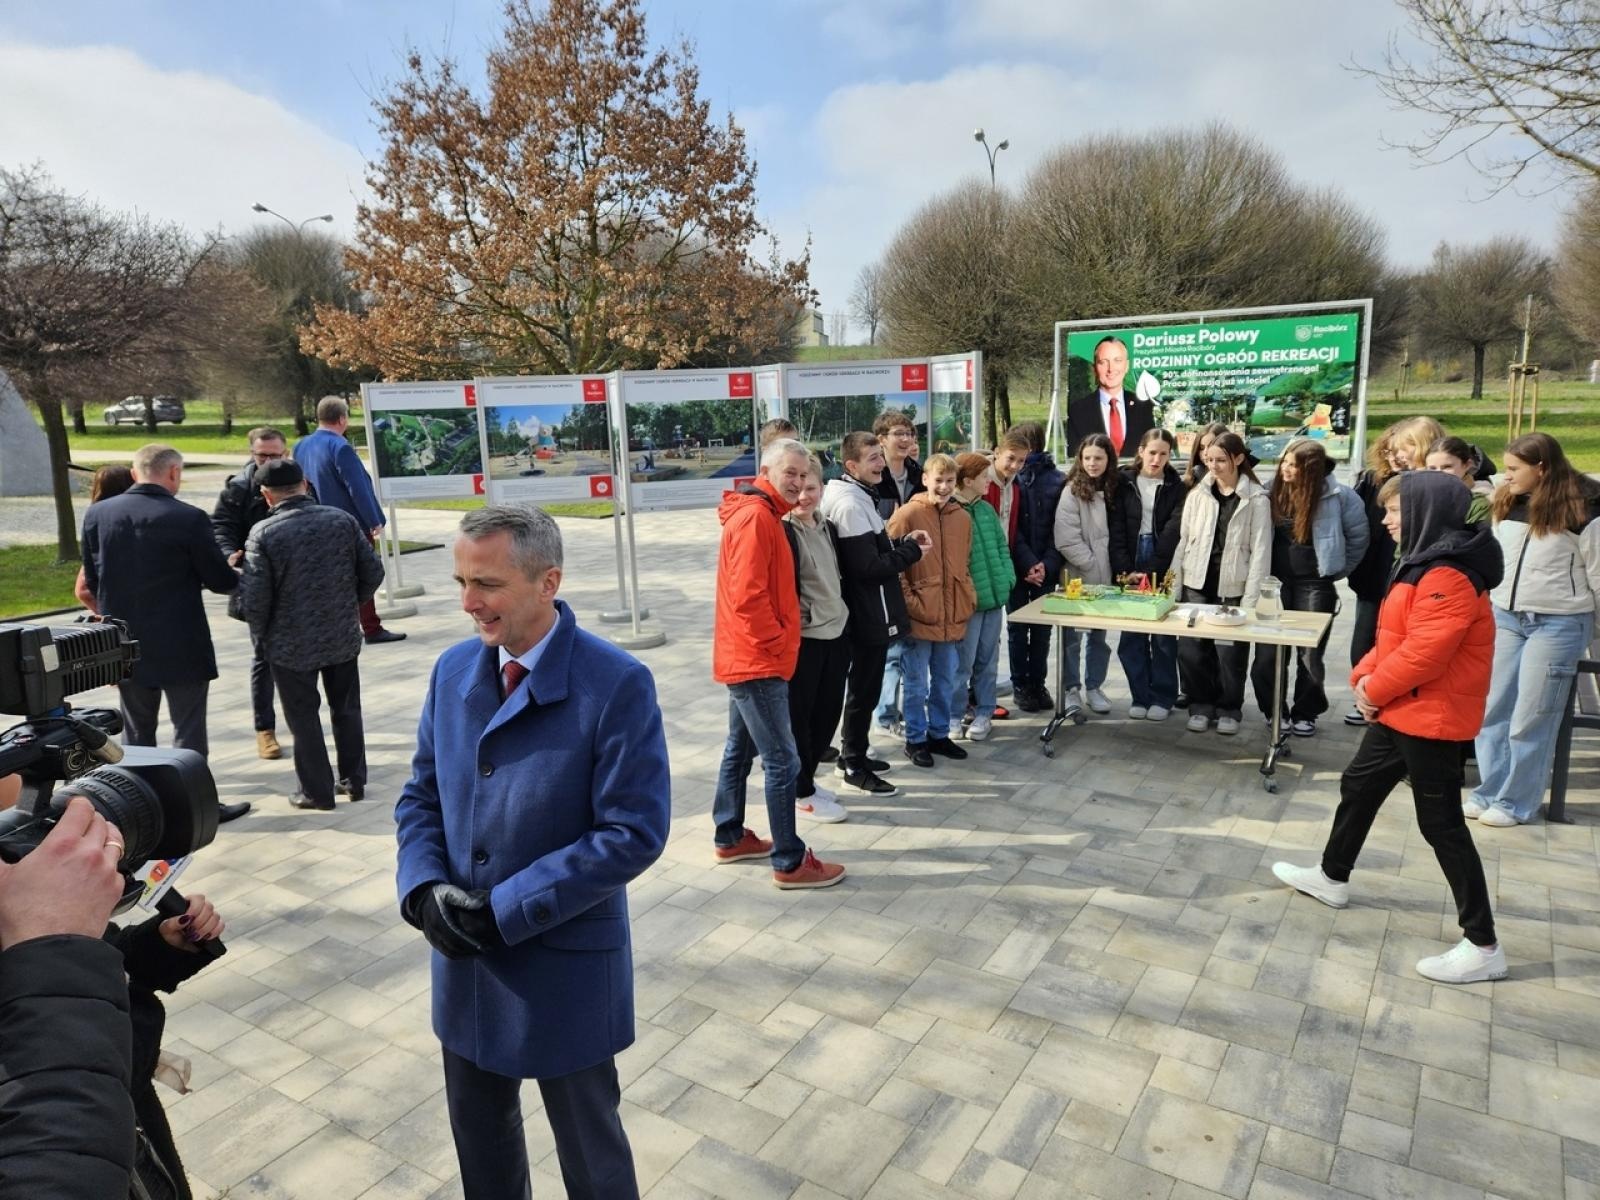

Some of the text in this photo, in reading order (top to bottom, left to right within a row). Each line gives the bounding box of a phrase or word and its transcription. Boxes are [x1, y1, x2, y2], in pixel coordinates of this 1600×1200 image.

[1133, 328, 1260, 347] Dariusz Polowy
[1133, 347, 1164, 355] Prezydent
[1133, 347, 1339, 369] RODZINNY OGRÓD REKREACJI
[1162, 370, 1180, 379] 90%
[1162, 379, 1187, 387] Prace
